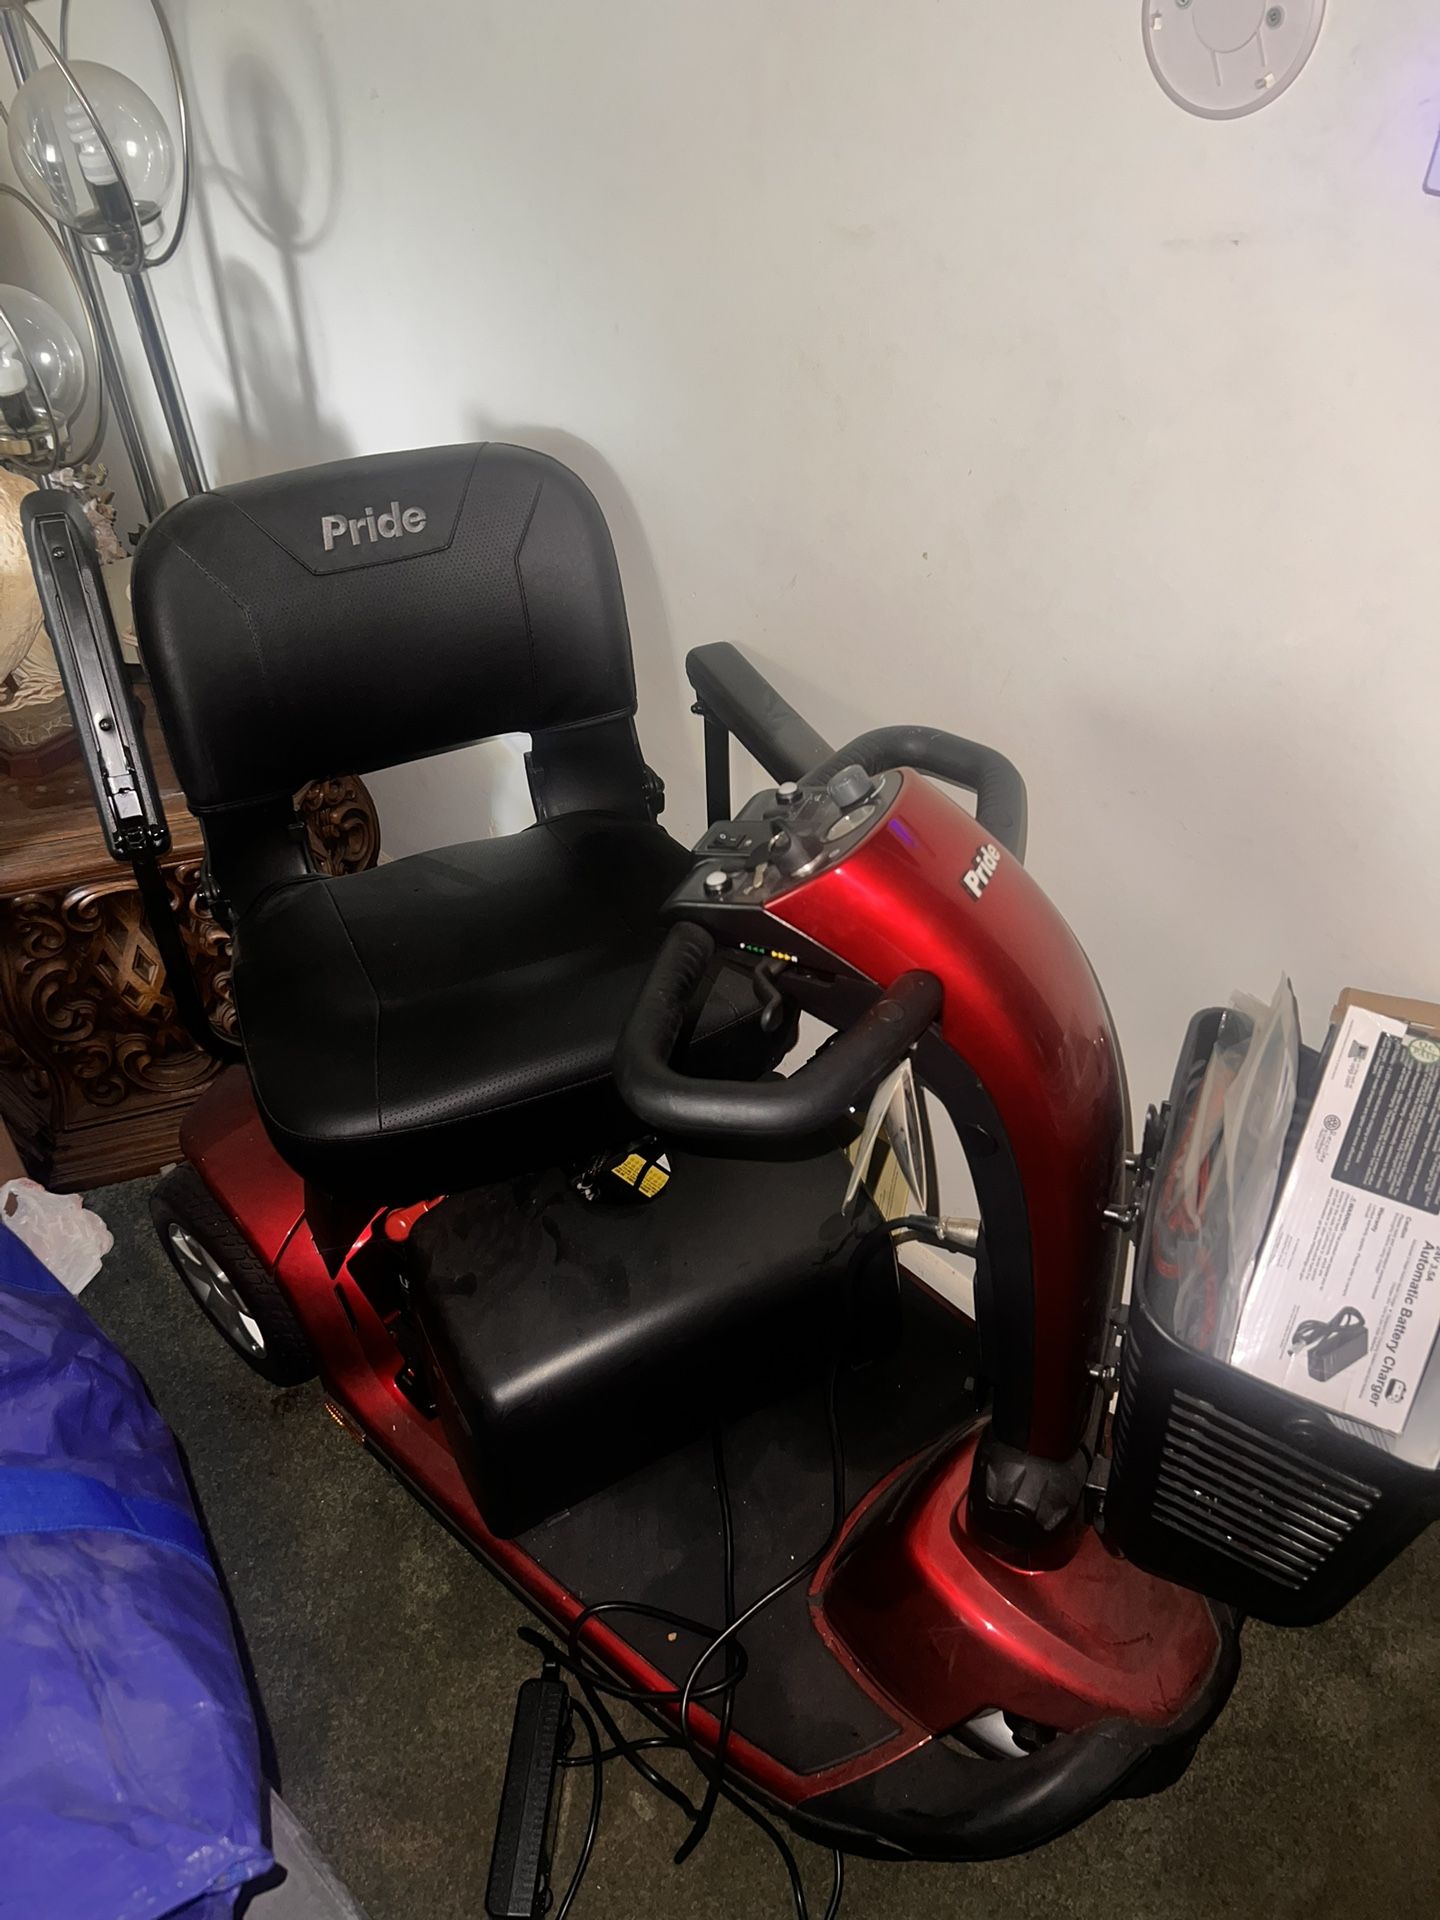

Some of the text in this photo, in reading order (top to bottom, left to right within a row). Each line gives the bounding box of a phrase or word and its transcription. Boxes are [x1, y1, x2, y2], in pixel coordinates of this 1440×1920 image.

[321, 501, 427, 551] Pride
[963, 843, 1001, 899] Pride
[1404, 1240, 1434, 1305] Automatic
[1386, 1307, 1413, 1353] Battery
[1369, 1355, 1396, 1407] Charger
